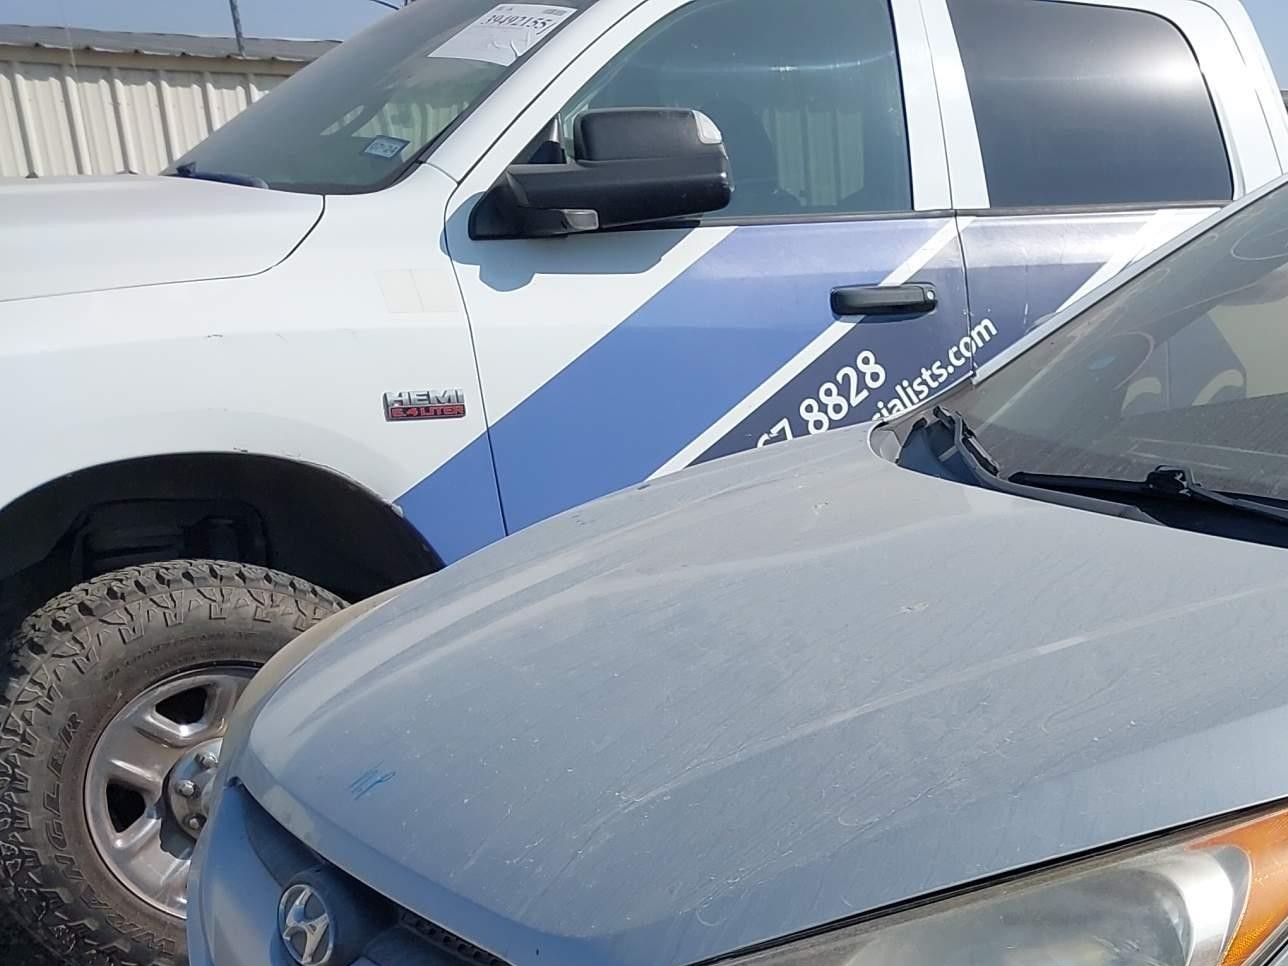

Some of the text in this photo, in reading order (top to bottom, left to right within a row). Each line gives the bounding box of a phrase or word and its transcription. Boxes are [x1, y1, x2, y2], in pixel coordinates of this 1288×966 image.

[383, 389, 465, 406] HEMI
[800, 350, 886, 435] 8828
[420, 404, 465, 417] LITER
